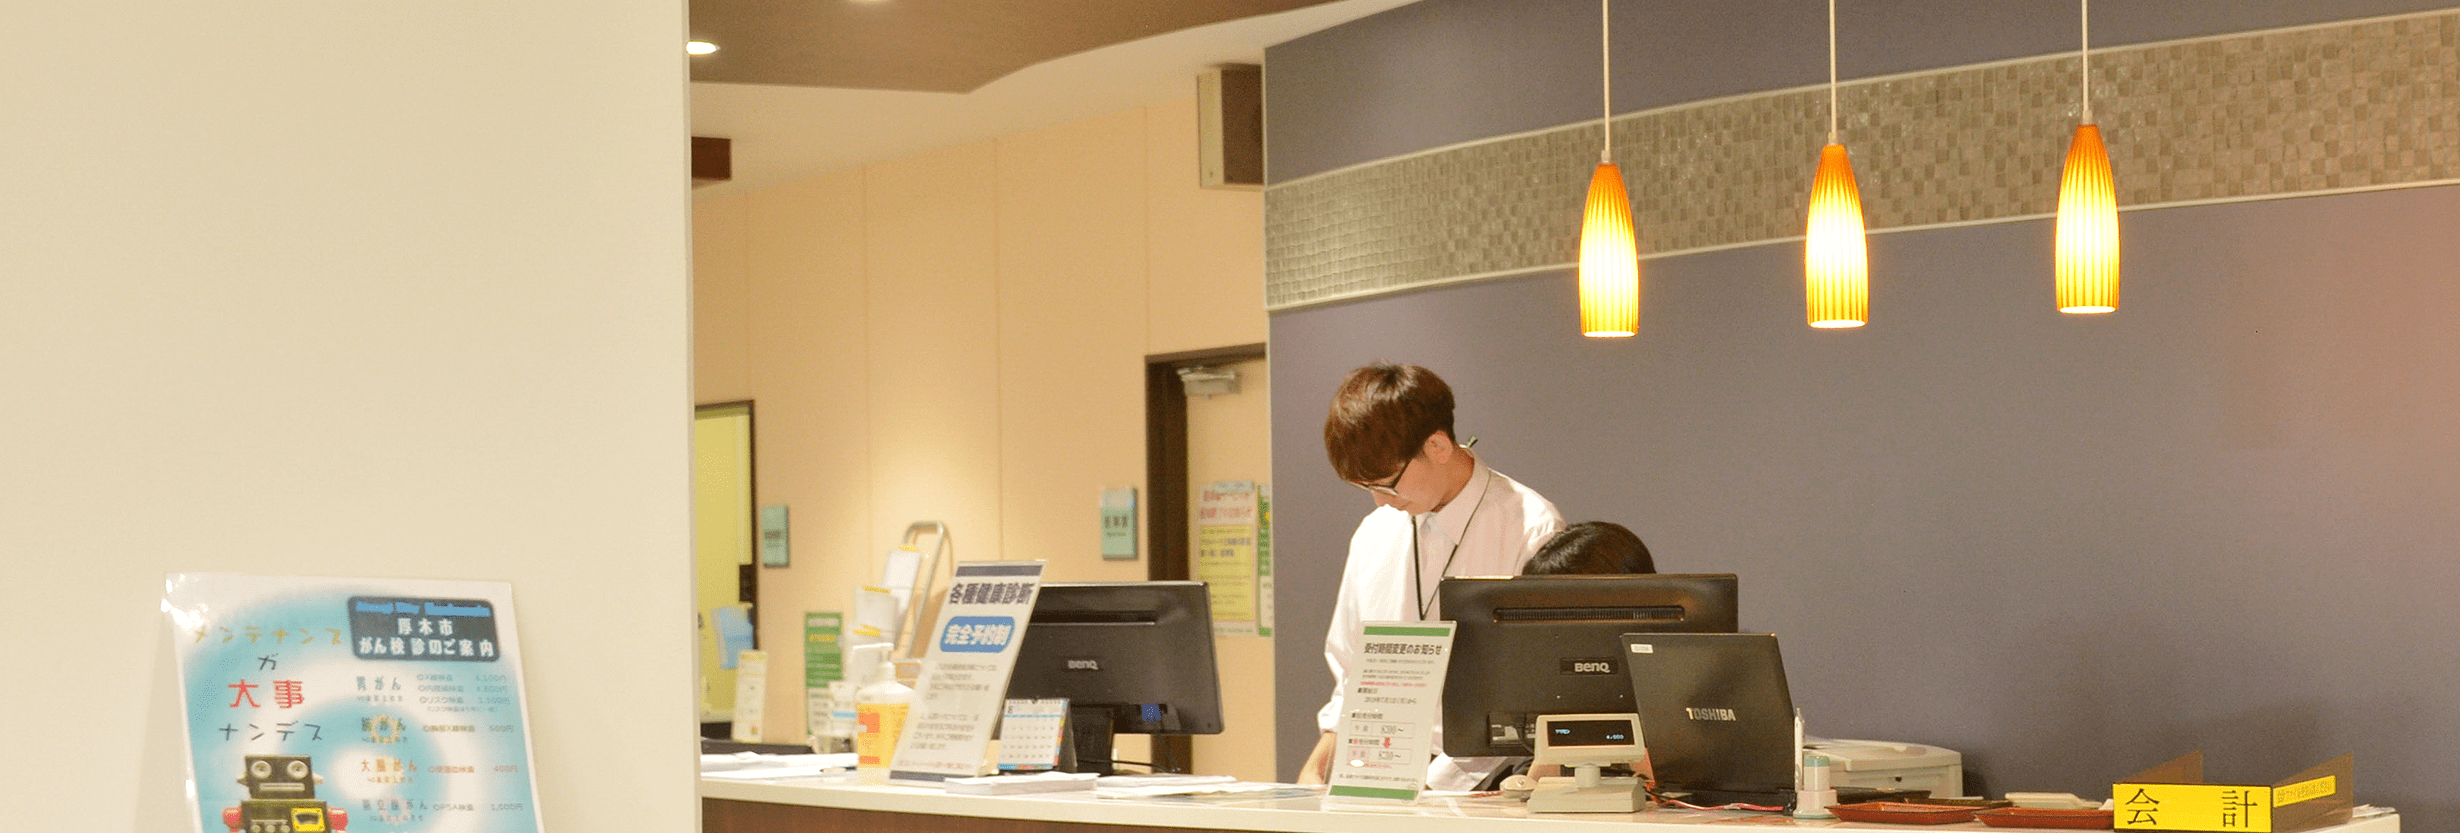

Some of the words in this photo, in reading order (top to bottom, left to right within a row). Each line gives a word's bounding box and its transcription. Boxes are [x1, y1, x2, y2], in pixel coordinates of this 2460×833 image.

[949, 582, 1036, 604] 各種健康診断
[195, 625, 342, 645] メンテナンス
[398, 618, 453, 636] 厚木市
[359, 636, 496, 657] がん検診のご案内
[258, 652, 279, 671] ガ
[1574, 662, 1611, 673] BenQ
[228, 679, 305, 708] 大事
[1685, 707, 1737, 721] TOSHIBA
[219, 720, 322, 741] ナンデス
[2125, 788, 2259, 828] 会計
